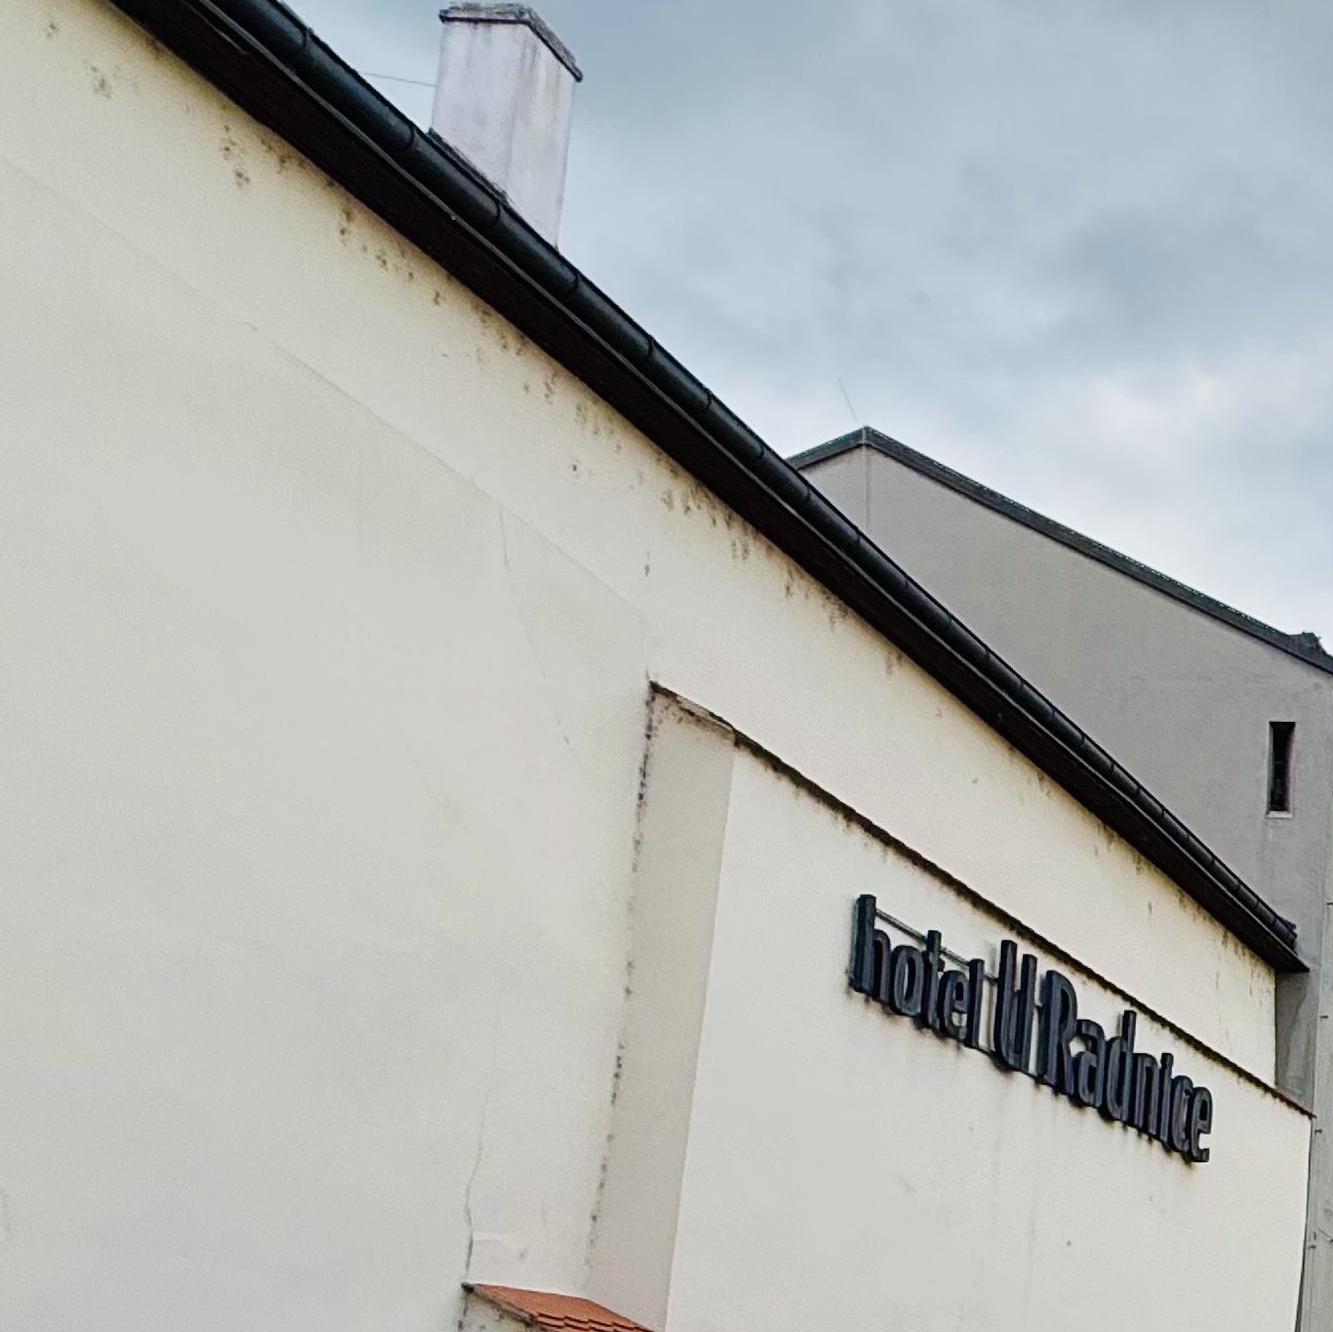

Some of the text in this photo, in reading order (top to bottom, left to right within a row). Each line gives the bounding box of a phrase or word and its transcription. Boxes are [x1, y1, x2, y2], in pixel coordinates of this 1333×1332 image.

[850, 894, 1213, 1163] hotel U Radnice
